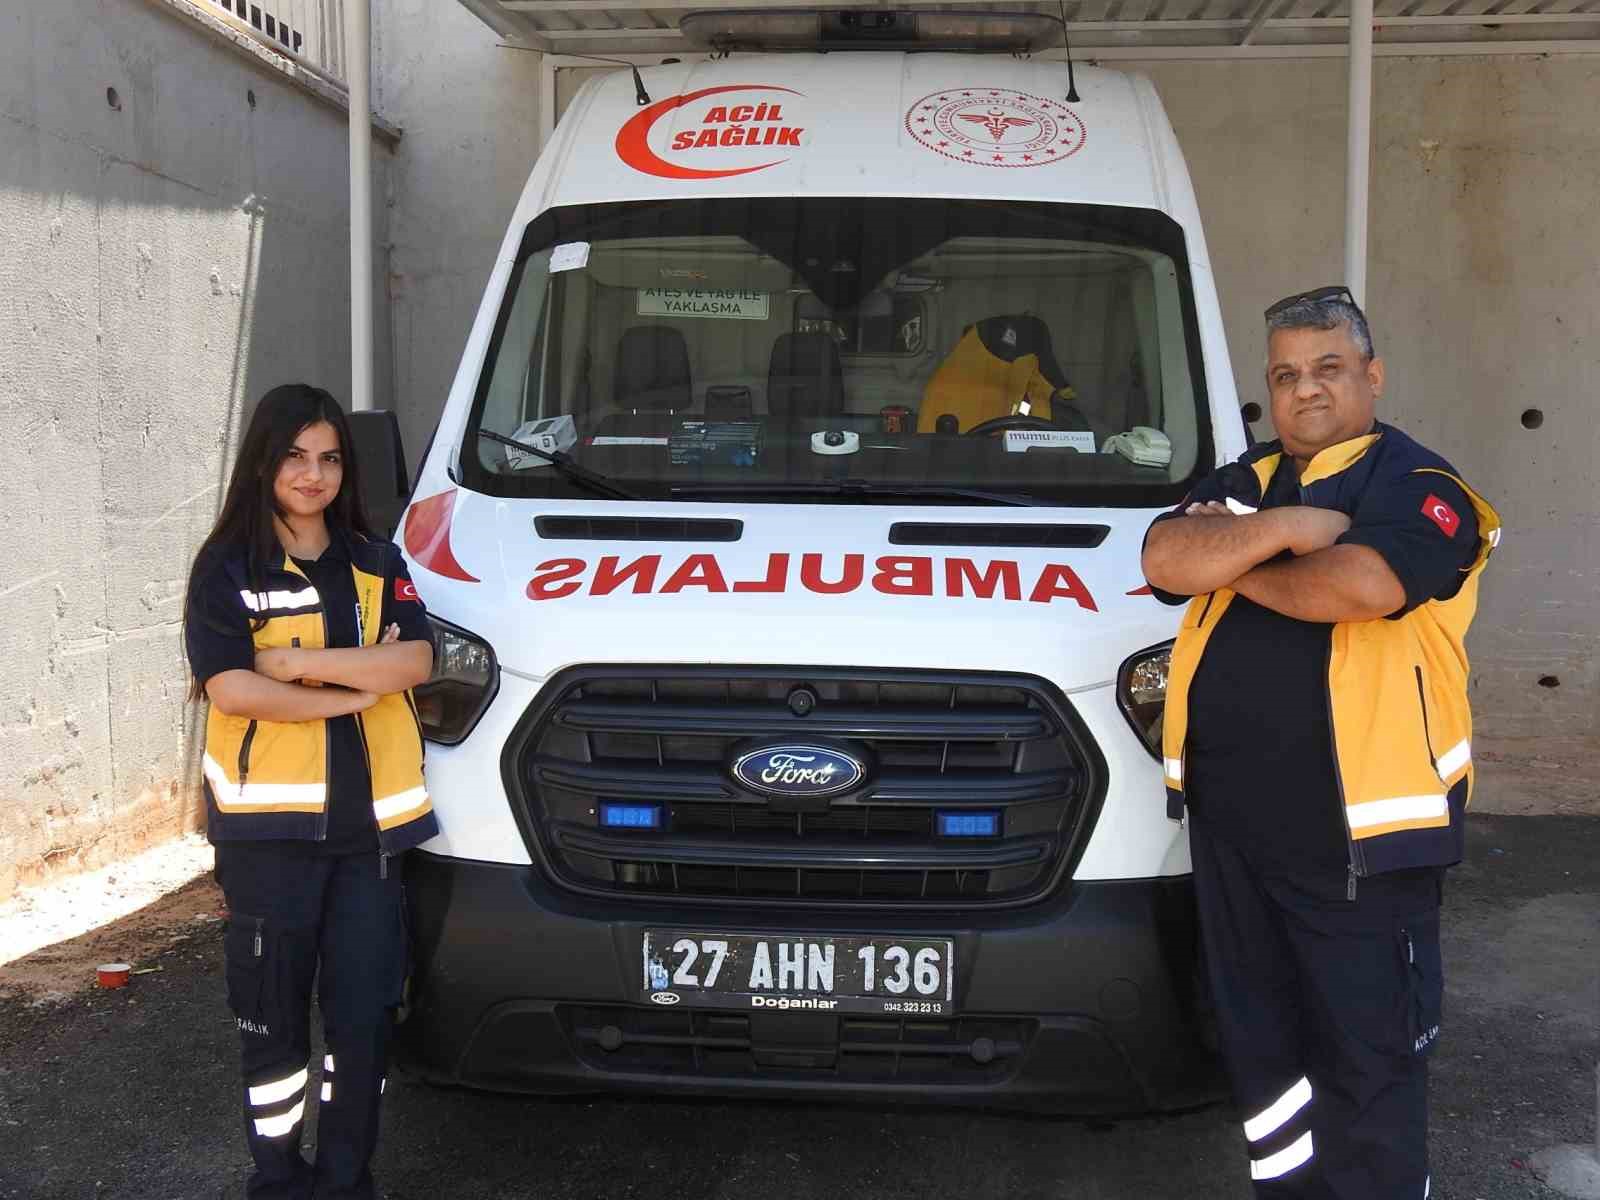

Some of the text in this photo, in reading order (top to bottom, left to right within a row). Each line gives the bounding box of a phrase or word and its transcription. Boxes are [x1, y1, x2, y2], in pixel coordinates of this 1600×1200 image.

[703, 102, 783, 123] ACİL
[672, 124, 804, 150] SAĞLIK
[761, 753, 834, 785] Ford
[672, 939, 940, 995] 27 AHN 136
[751, 995, 838, 1010] Doğanlar
[903, 1002, 919, 1013] 323
[920, 1003, 931, 1013] 23
